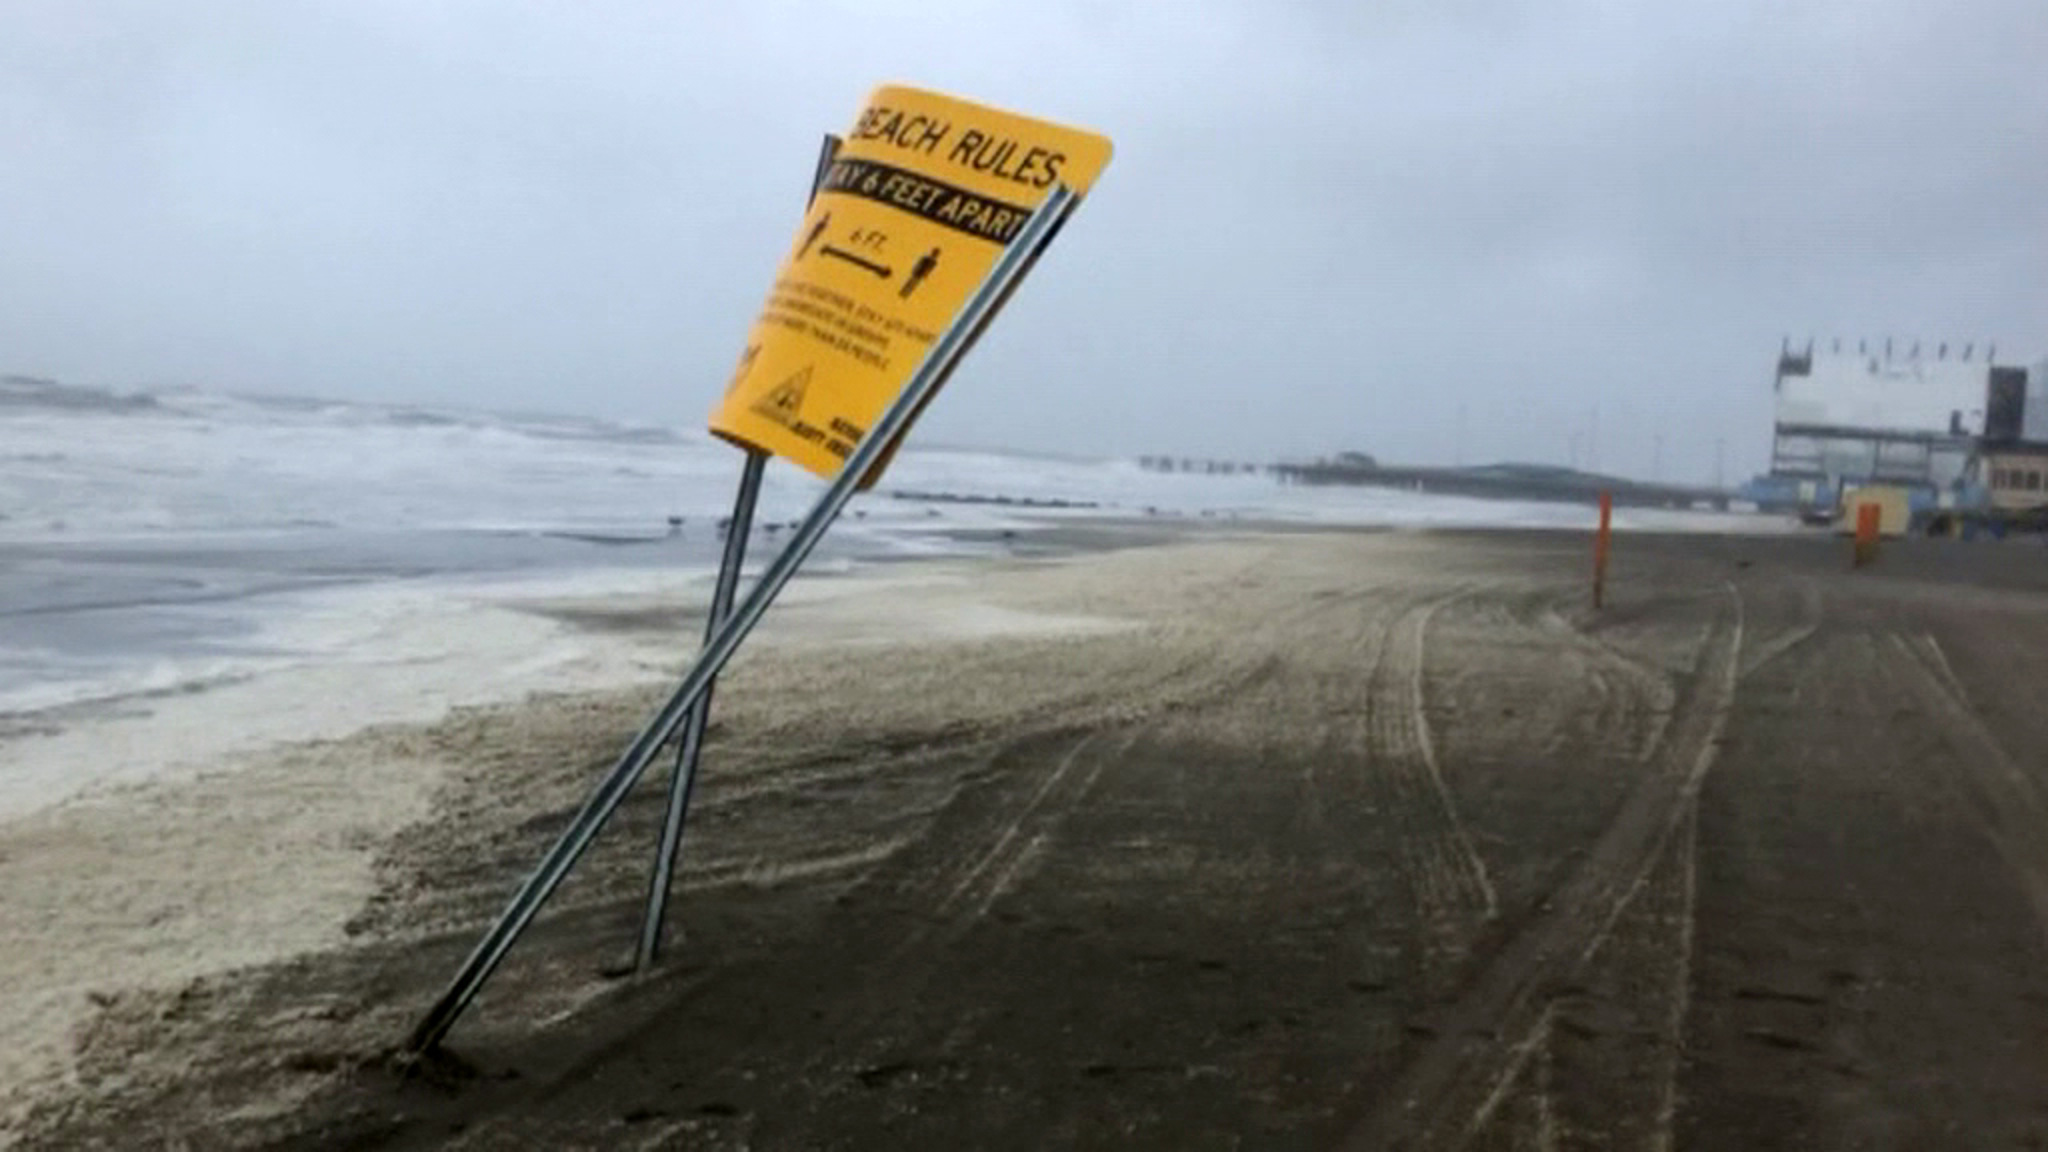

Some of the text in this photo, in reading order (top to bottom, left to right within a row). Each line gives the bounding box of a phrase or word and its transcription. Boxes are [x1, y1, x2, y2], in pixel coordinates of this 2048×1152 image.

[948, 129, 1067, 189] RULES
[824, 161, 1027, 240] TAY 6 FEET APART
